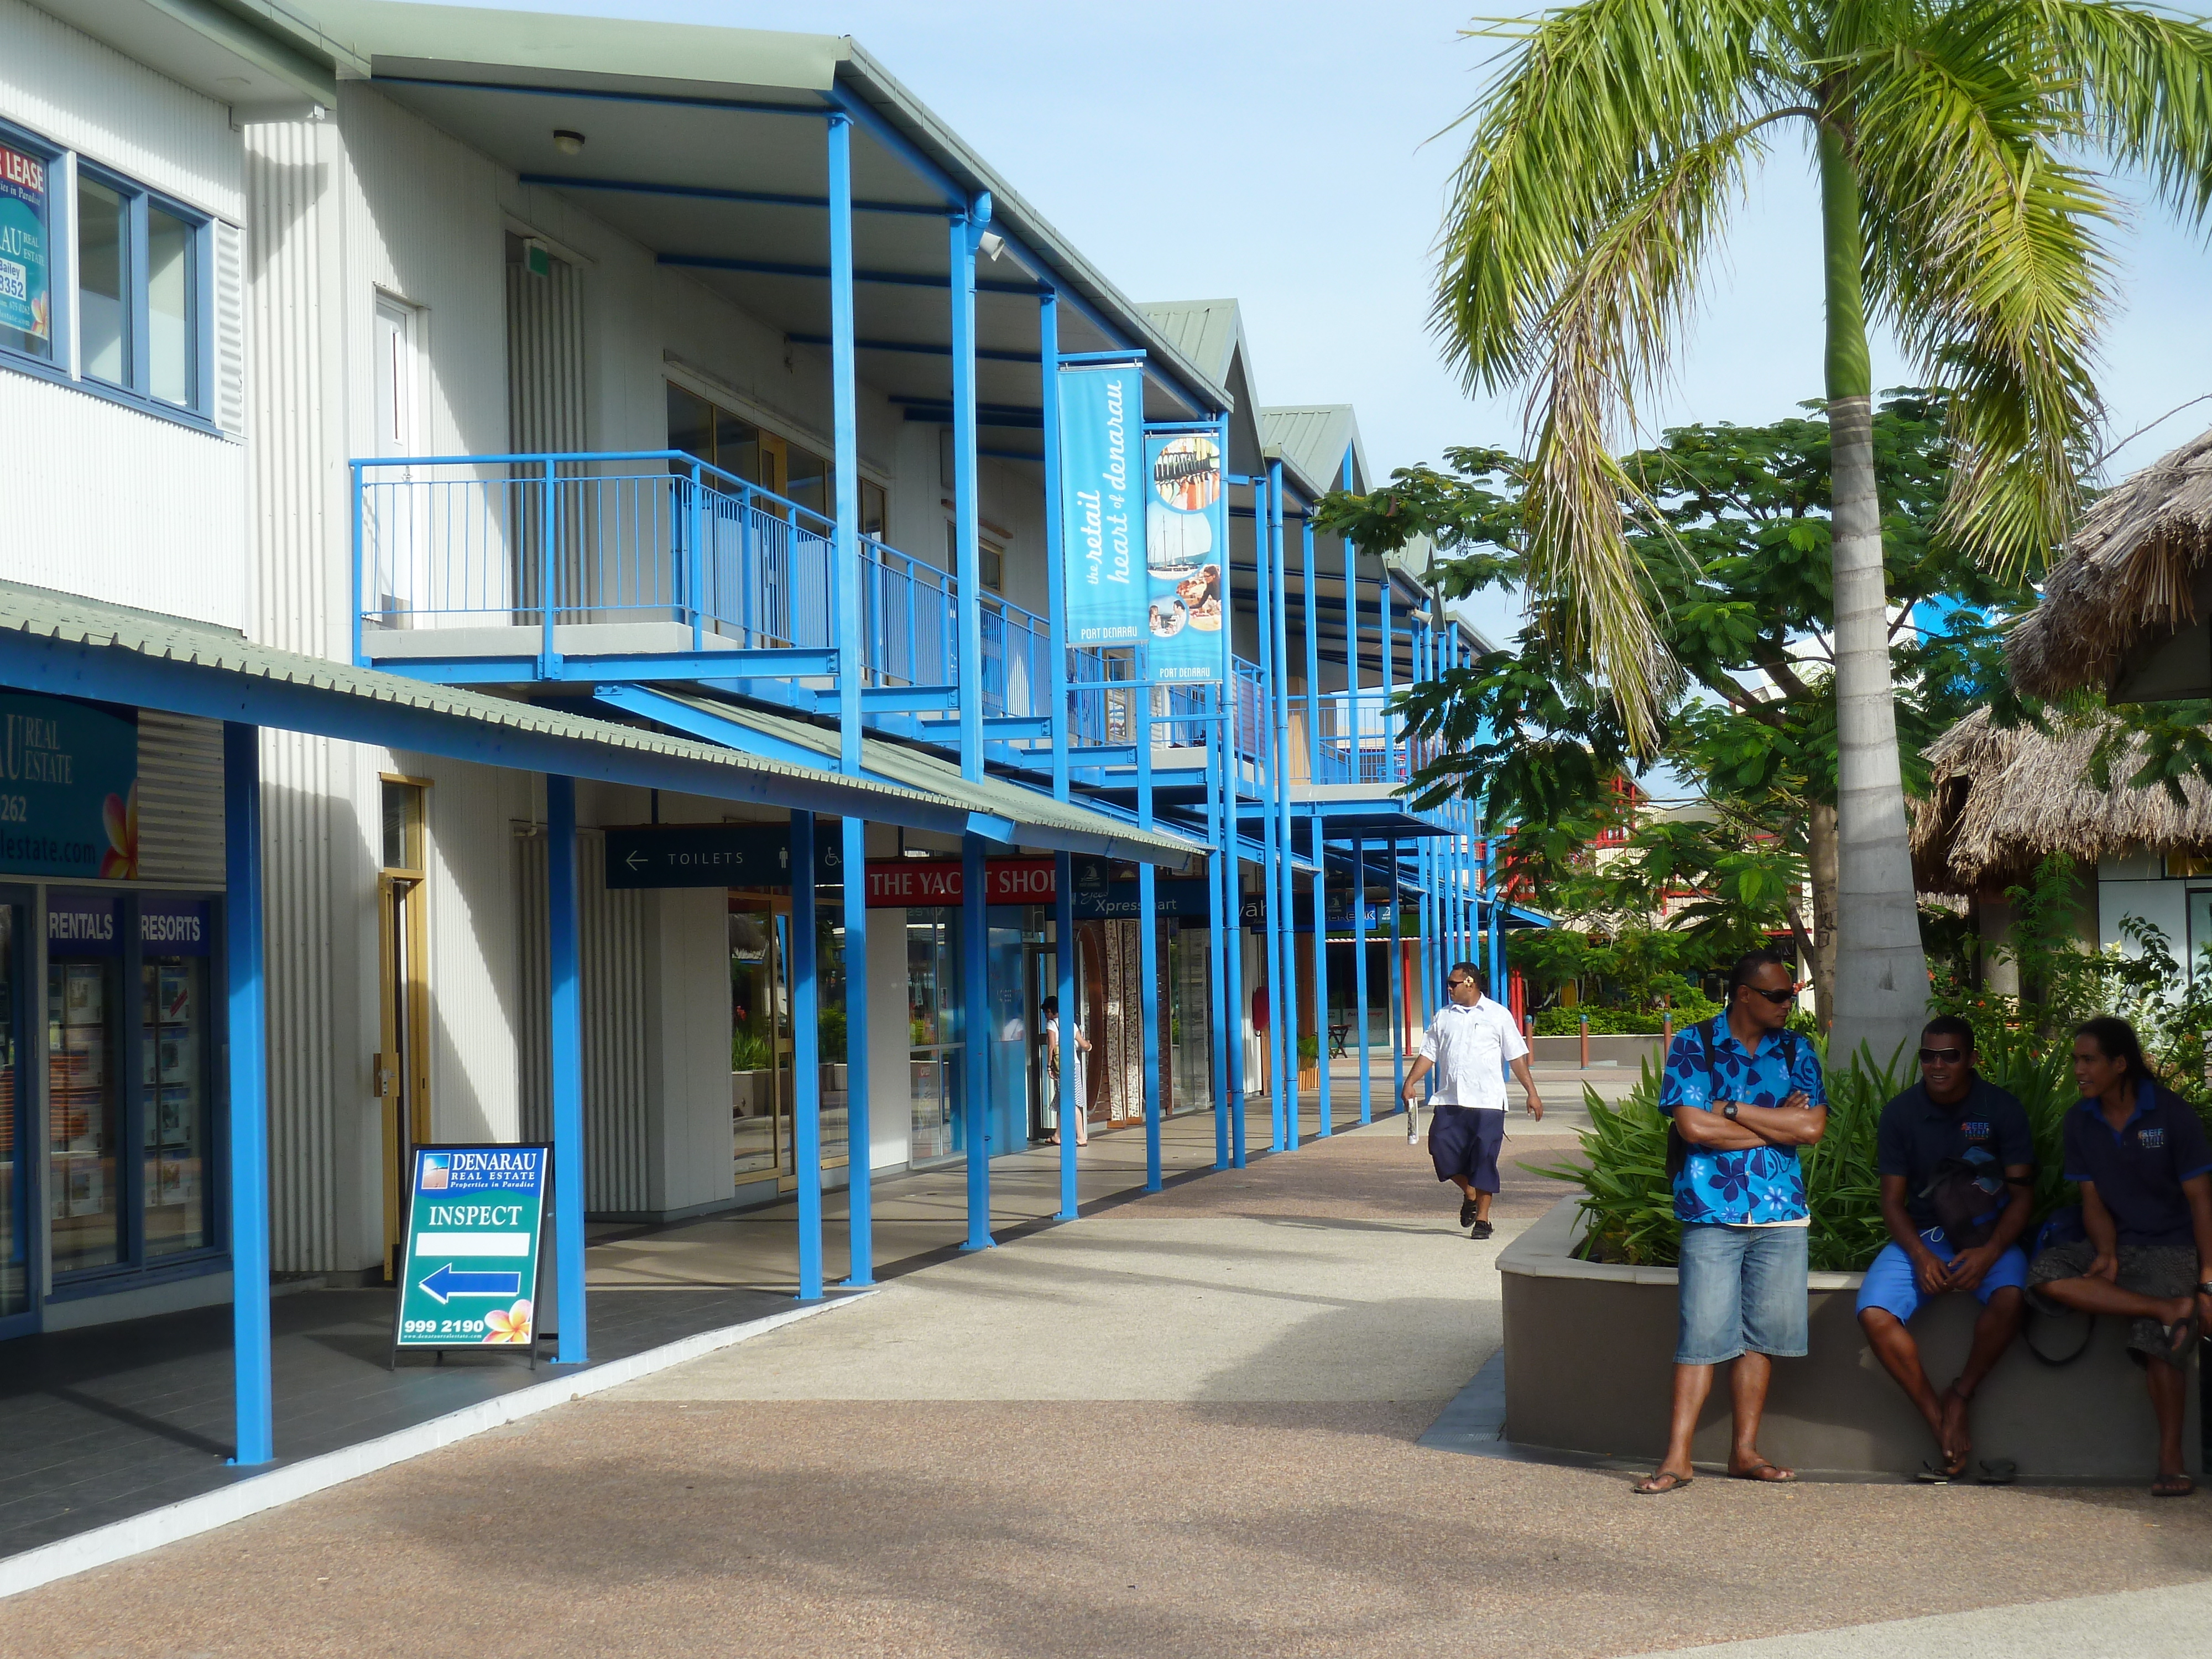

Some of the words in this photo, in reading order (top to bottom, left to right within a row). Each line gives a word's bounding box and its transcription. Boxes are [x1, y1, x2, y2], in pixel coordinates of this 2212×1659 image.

[6, 151, 44, 192] LEASE
[0, 180, 8, 193] ies
[11, 185, 17, 196] in
[19, 187, 40, 206] Paradise
[0, 225, 22, 255] AU
[23, 232, 39, 248] REAL
[24, 249, 44, 266] ESTATE
[1102, 379, 1126, 491] denarau
[1109, 494, 1125, 509] of
[1077, 489, 1103, 564] retail
[1107, 513, 1130, 584] heart
[1086, 564, 1099, 585] the
[1081, 628, 1100, 640] PORT
[1103, 626, 1138, 639] DENARAU
[1160, 667, 1177, 677] PORT
[1179, 667, 1211, 677] DENARAU
[25, 717, 60, 750] REAL
[25, 750, 72, 784] ESTATE
[1, 794, 27, 822] 262
[0, 828, 96, 864] lestate.com
[667, 852, 743, 865] TOILETS
[869, 873, 912, 896] THE
[919, 870, 993, 896] YACT
[1095, 898, 1177, 915] Xpressart
[49, 912, 113, 941] RENTALS
[141, 915, 201, 942] RESORTS
[452, 1153, 537, 1171] DENARAU
[451, 1172, 482, 1180] REAL
[489, 1172, 535, 1180] ESTATE
[429, 1206, 522, 1227] INSPECT
[404, 1320, 437, 1333] 999
[441, 1320, 484, 1333] 2190
